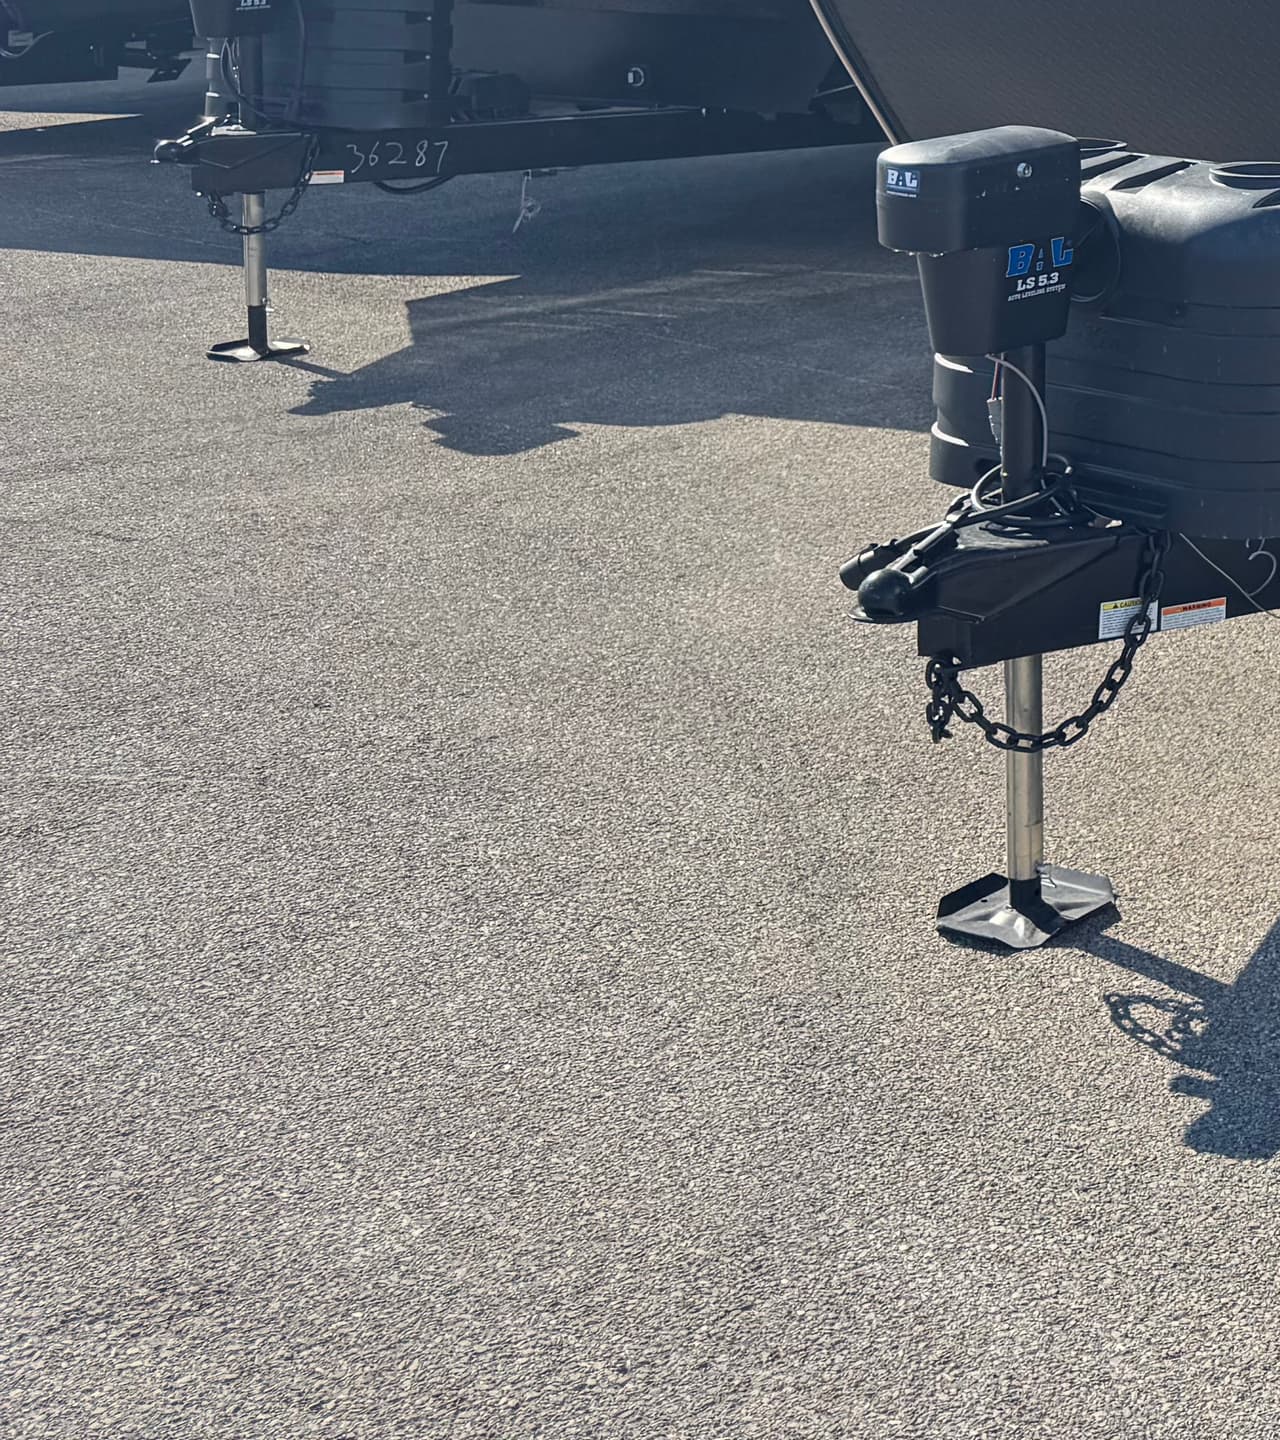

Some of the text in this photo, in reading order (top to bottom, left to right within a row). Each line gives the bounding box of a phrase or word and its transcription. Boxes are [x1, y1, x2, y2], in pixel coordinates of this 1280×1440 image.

[346, 140, 449, 173] 36287
[1017, 272, 1060, 291] LS 5.3
